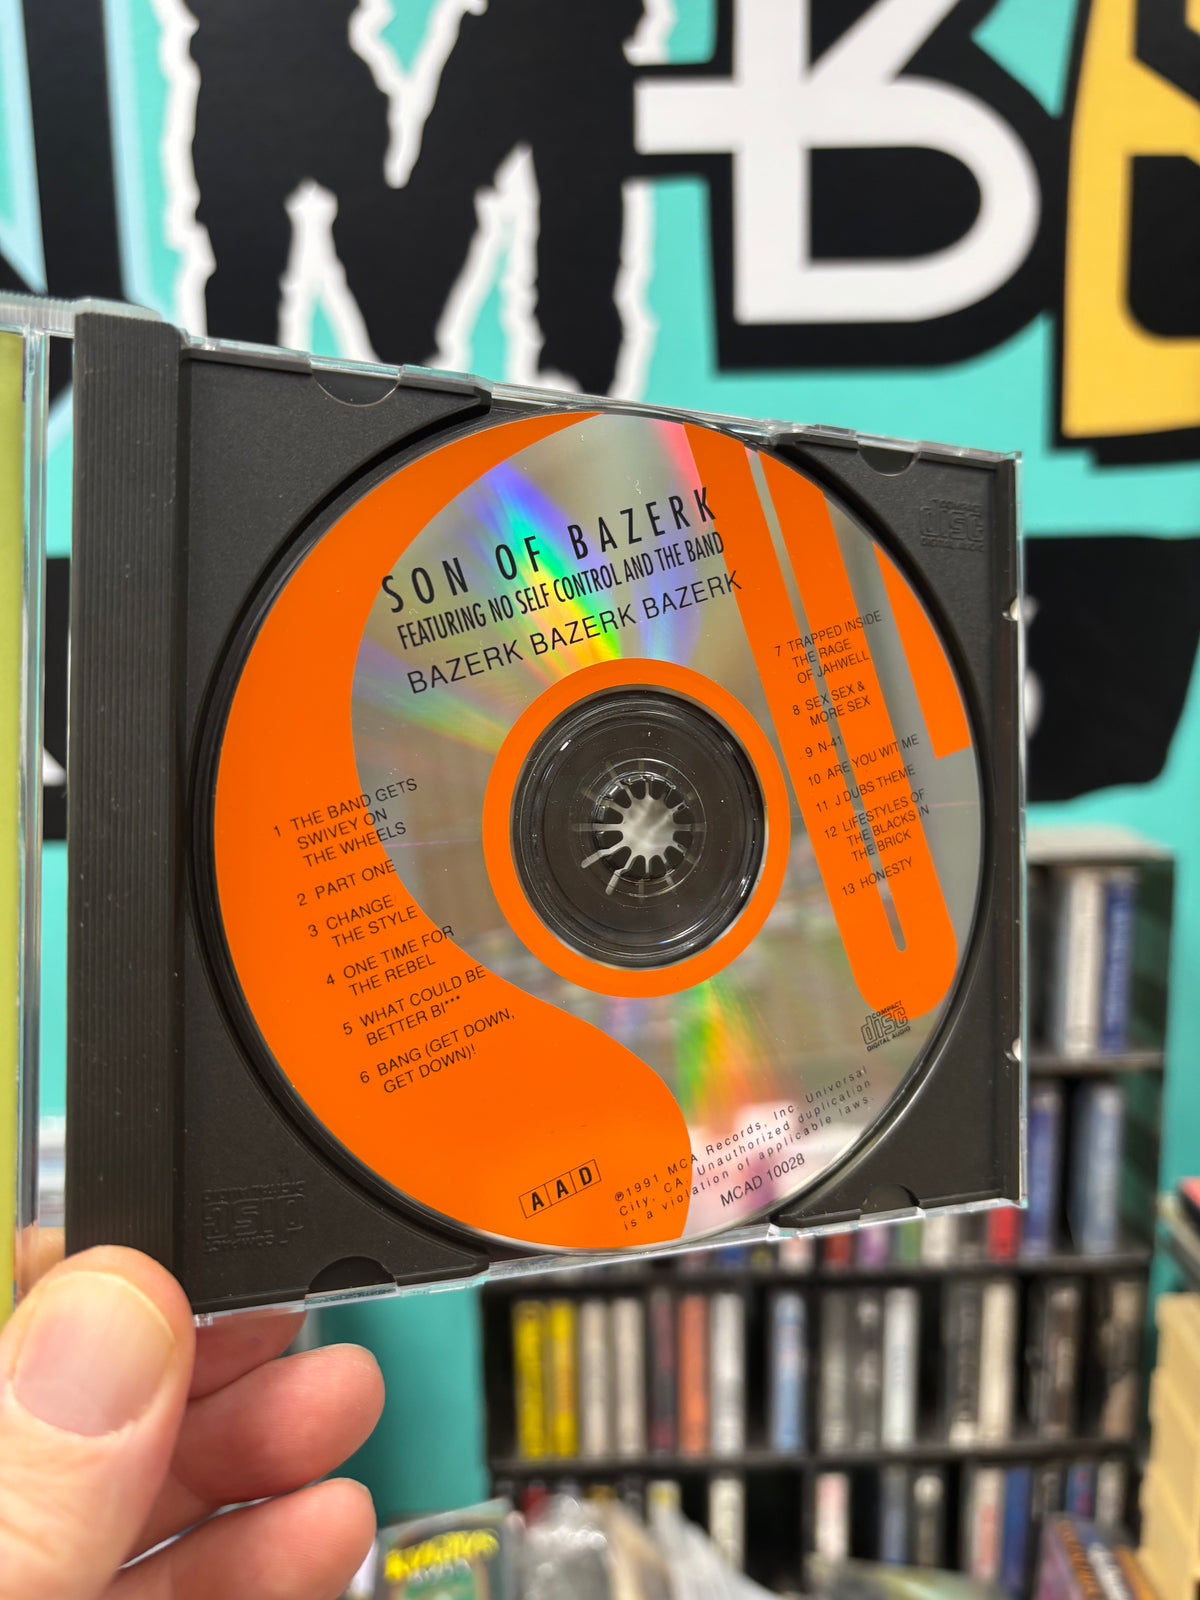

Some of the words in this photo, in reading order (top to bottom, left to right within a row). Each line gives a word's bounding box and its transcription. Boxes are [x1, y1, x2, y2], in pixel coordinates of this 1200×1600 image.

[381, 557, 469, 614] SON
[495, 535, 542, 580] OF
[567, 487, 716, 560] BAZERK
[397, 602, 487, 650] FEATURING
[488, 594, 514, 623] NO
[515, 582, 551, 615] SELF
[553, 563, 622, 603] CONTROL
[624, 553, 654, 583] AND
[654, 543, 684, 573] THE
[688, 531, 725, 563] BAND
[407, 639, 524, 694] BAZERK
[529, 603, 637, 656] BAZERK
[641, 570, 742, 620] BAZERK
[774, 645, 781, 657] 7
[787, 624, 842, 652] TRAPPED
[844, 610, 882, 632] INSIDE
[792, 650, 817, 668] THE
[819, 638, 852, 659] RAGE
[797, 669, 813, 684] OF
[817, 650, 870, 678] JAHWELL
[792, 705, 800, 716] 8
[805, 693, 830, 711] SEX
[831, 684, 855, 702] SEX
[857, 681, 865, 692] &
[809, 705, 846, 727] MORE
[847, 695, 871, 713] SEX
[805, 746, 813, 758] 9
[817, 735, 843, 753] N-41
[808, 773, 821, 787] 10
[827, 760, 850, 780] ARE
[851, 751, 877, 768] YOU
[878, 741, 900, 758] WIT
[901, 734, 919, 750] ME
[273, 825, 281, 837] 1
[290, 810, 325, 832] THE
[327, 793, 372, 819] BAND
[375, 778, 418, 802] GETS
[816, 800, 828, 813] 11
[835, 795, 841, 806] J
[843, 781, 875, 802] DUBS
[876, 764, 916, 789] THEME
[297, 817, 360, 850] SWIVEY
[363, 807, 388, 826] ON
[824, 826, 838, 840] 12
[842, 796, 909, 832] LIFESTYLES
[910, 788, 926, 803] OF
[846, 829, 871, 847] THE
[872, 810, 916, 836] BLACKS
[918, 804, 930, 817] IN
[302, 846, 338, 868] THE
[339, 821, 407, 855] WHEELS
[851, 844, 875, 862] THE
[876, 829, 912, 852] BRICK
[296, 893, 307, 906] 2
[314, 873, 357, 900] PART
[361, 859, 397, 882] ONE
[842, 883, 855, 896] 13
[859, 856, 913, 889] HONESTY
[308, 924, 318, 937] 3
[326, 894, 394, 930] CHANGE
[331, 926, 366, 948] THE
[368, 905, 419, 934] STYLE
[326, 974, 335, 986] 4
[343, 955, 378, 980] ONE
[380, 939, 419, 964] TIME
[421, 925, 455, 948] FOR
[348, 975, 382, 997] THE
[384, 953, 436, 983] REBEL
[343, 1022, 353, 1035] 5
[359, 998, 405, 1028] WHAT
[409, 975, 462, 1007] COULD
[465, 965, 486, 984] BE
[871, 1000, 902, 1019] COMPACT
[360, 1071, 370, 1084] 6
[376, 1048, 422, 1076] BANG
[425, 1029, 460, 1058] (GET
[463, 1008, 515, 1038] DOWN,
[366, 1011, 429, 1046] BETTER
[860, 1006, 909, 1045] disc
[892, 1025, 911, 1039] AUDIO
[383, 1070, 416, 1093] GET
[418, 1043, 476, 1078] DOWN)!
[667, 1153, 698, 1176] MCA
[805, 1065, 867, 1103] Universal
[697, 1121, 790, 1176] Unauthorized
[798, 1080, 871, 1123] duplication
[624, 1219, 637, 1230] is
[646, 1210, 653, 1219] a
[662, 1170, 729, 1210] violation
[737, 1157, 750, 1171] of
[759, 1116, 831, 1160] applicable
[720, 1175, 763, 1207] MCAD
[766, 1153, 805, 1182] 10028
